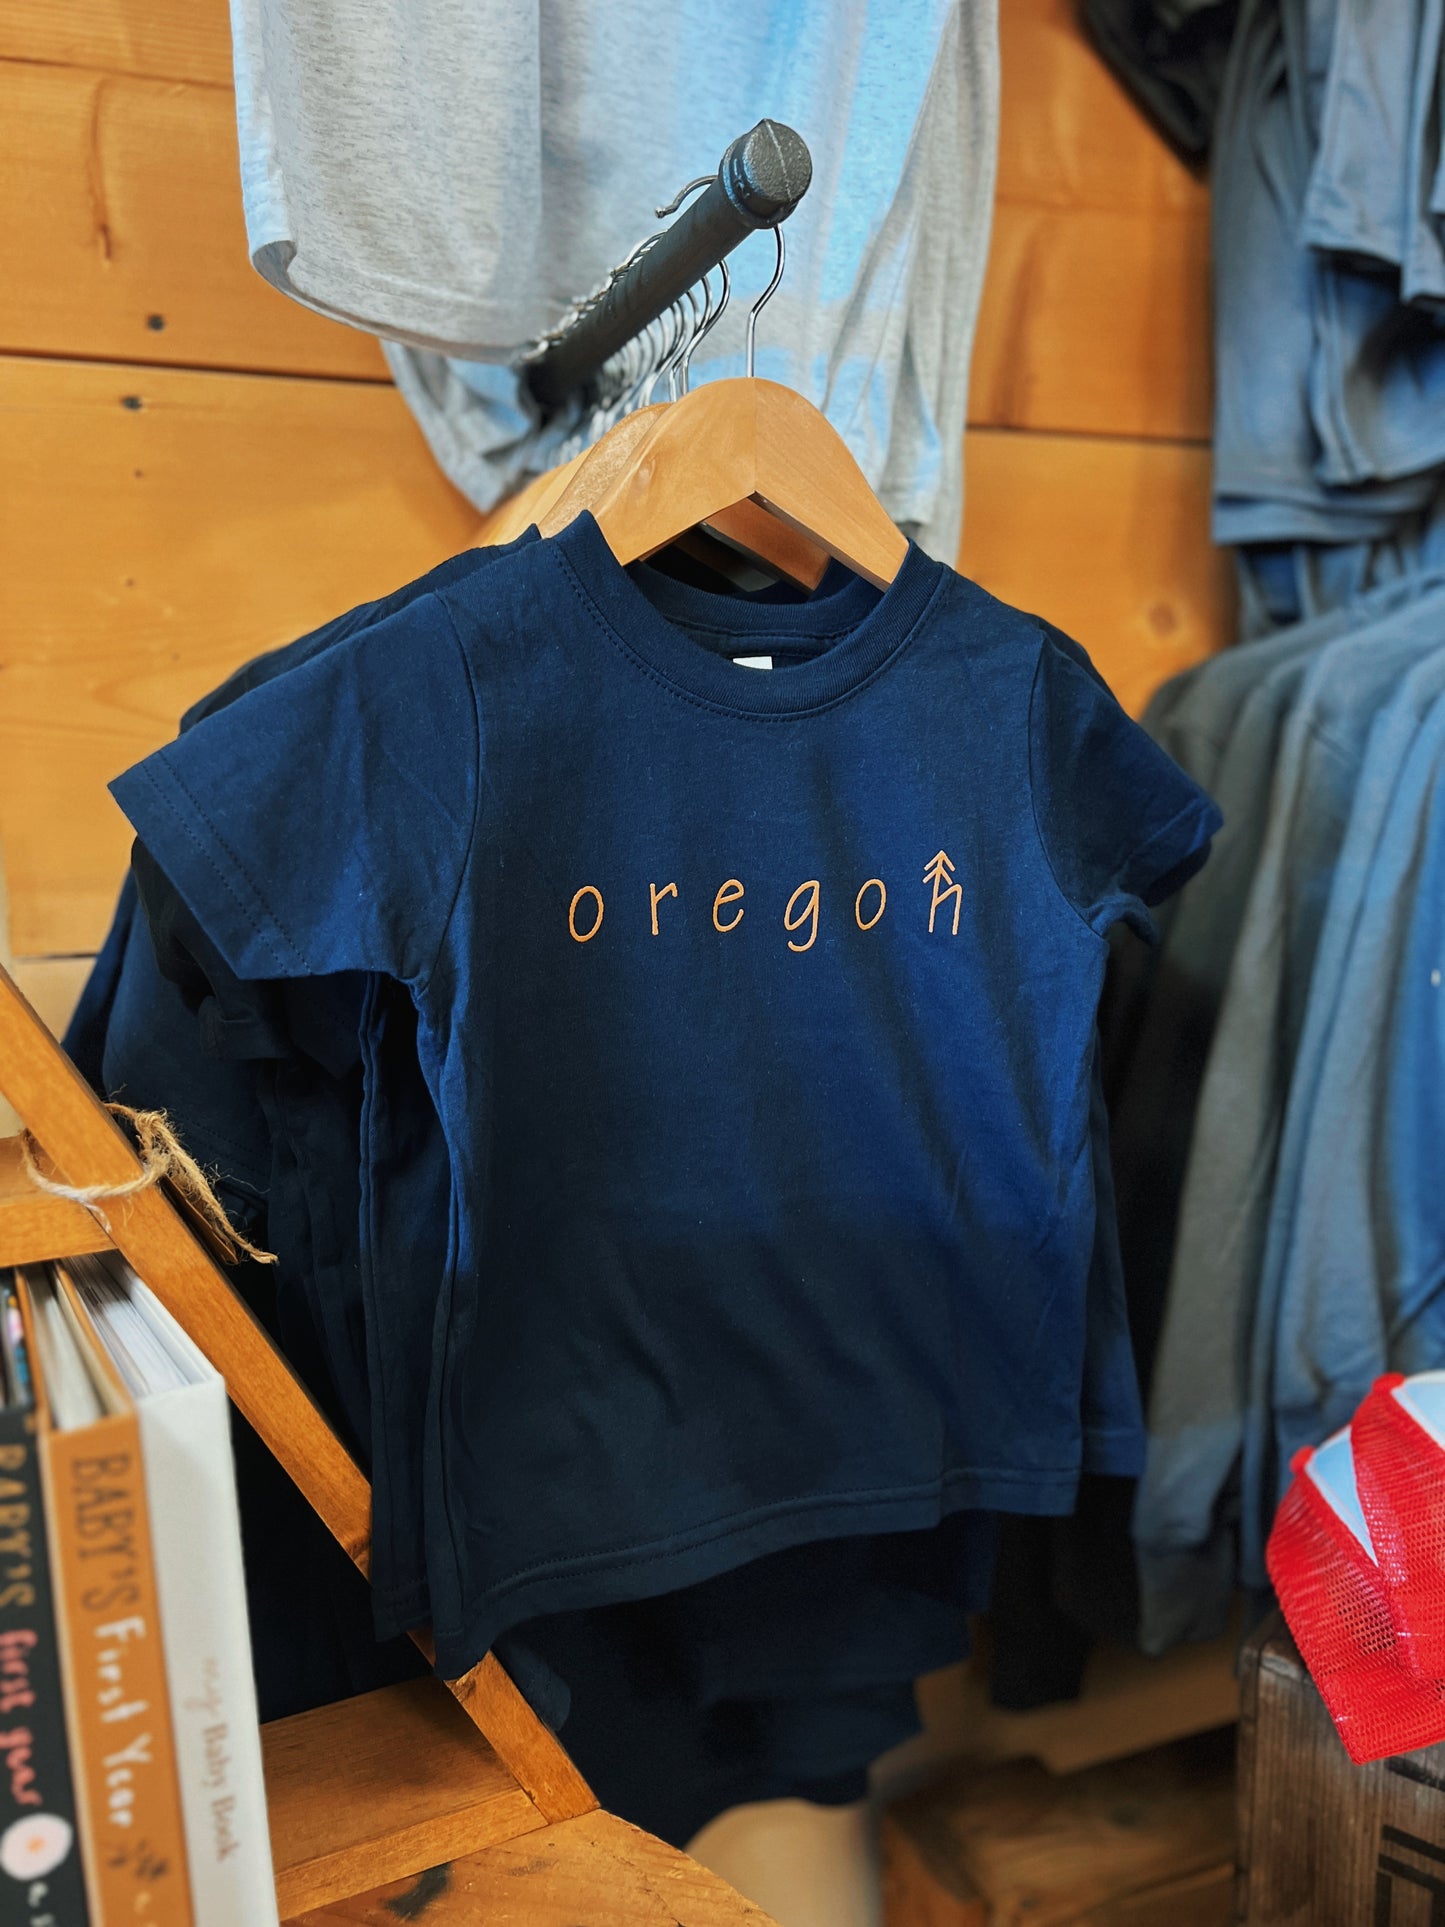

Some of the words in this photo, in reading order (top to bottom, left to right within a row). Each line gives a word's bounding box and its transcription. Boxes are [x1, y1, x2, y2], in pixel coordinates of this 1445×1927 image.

[568, 850, 962, 952] oregon
[71, 1453, 140, 1613] BABY'S
[94, 1615, 148, 1724] First
[103, 1732, 153, 1829] Year
[211, 1795, 241, 1864] Book
